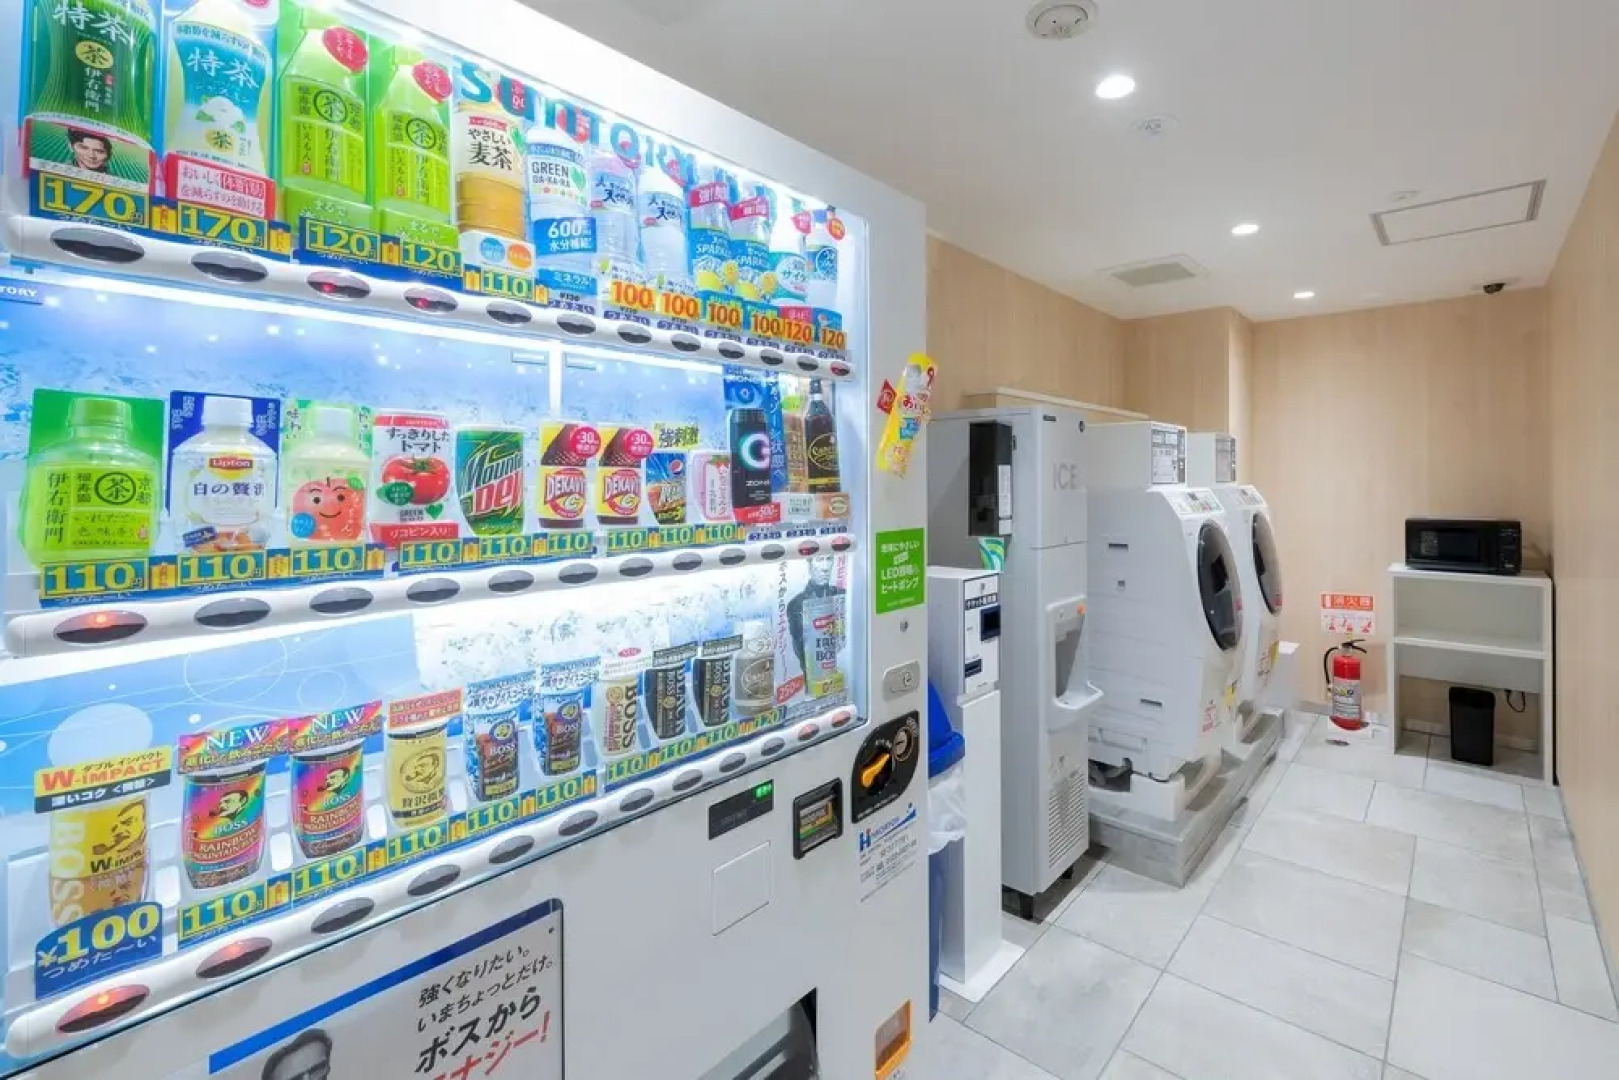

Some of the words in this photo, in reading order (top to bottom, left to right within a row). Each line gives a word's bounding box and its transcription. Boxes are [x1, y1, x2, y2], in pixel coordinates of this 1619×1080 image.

[53, 2, 132, 43] 特茶
[84, 44, 106, 65] 茶
[187, 47, 260, 89] 特茶
[320, 93, 345, 119] 茶
[413, 122, 433, 145] 茶
[468, 128, 511, 145] やさしい
[469, 142, 512, 170] 麦茶
[532, 161, 570, 178] GREEN
[612, 281, 651, 308] 100
[662, 292, 698, 318] 100
[709, 302, 740, 326] 100
[752, 313, 782, 336] 100
[787, 320, 812, 342] 120
[821, 328, 844, 348] 120
[386, 426, 450, 443] すっきりした
[401, 441, 441, 453] トマト
[212, 458, 251, 470] Lipton
[1053, 462, 1079, 491] ICE
[105, 477, 130, 500] 茶
[45, 472, 68, 545] 伊右衛門
[389, 526, 448, 538] リコピン入り
[310, 706, 366, 735] NEW
[205, 723, 270, 751] NEW
[42, 758, 164, 791] W-IMPACT
[213, 817, 248, 838] BOSS
[198, 827, 258, 855] RAINBOW
[51, 821, 86, 928] BOSS
[37, 904, 160, 968] ¥100
[418, 944, 531, 1009] 強くなりたい。
[416, 952, 553, 1033] いまちょっとだけ。
[413, 984, 543, 1074] ボスから
[431, 1008, 552, 1080] ナジー!
